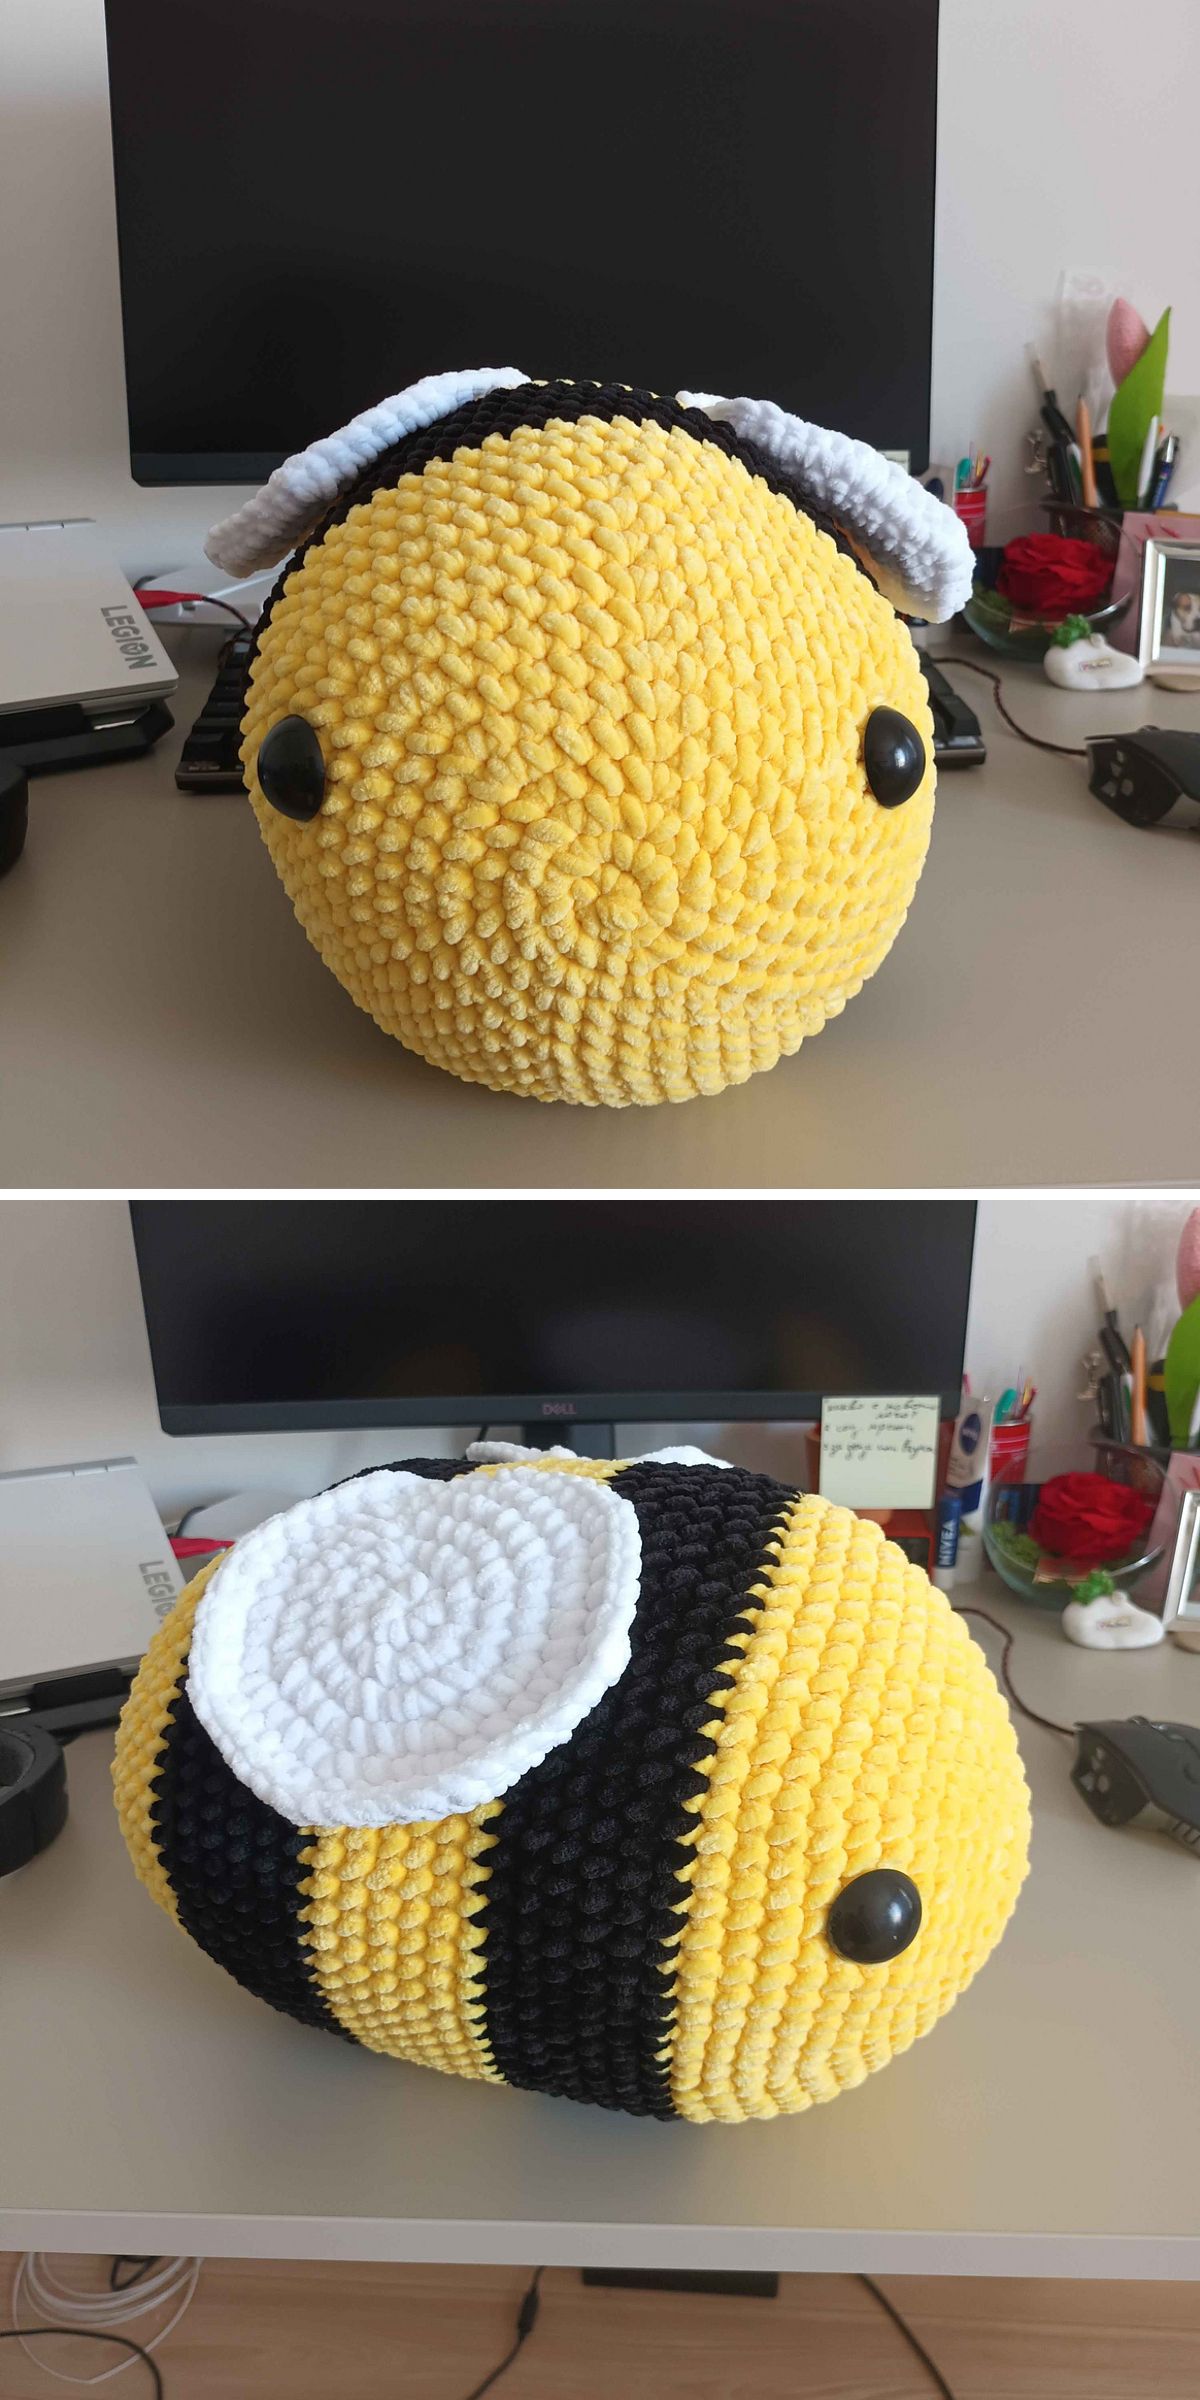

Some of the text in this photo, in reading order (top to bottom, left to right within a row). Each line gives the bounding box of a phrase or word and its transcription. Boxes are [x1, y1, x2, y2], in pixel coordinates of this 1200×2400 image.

[100, 604, 158, 670] LEGION
[543, 1402, 577, 1415] DELL
[938, 1519, 957, 1567] NIVEA
[138, 1560, 178, 1625] LEGIO
